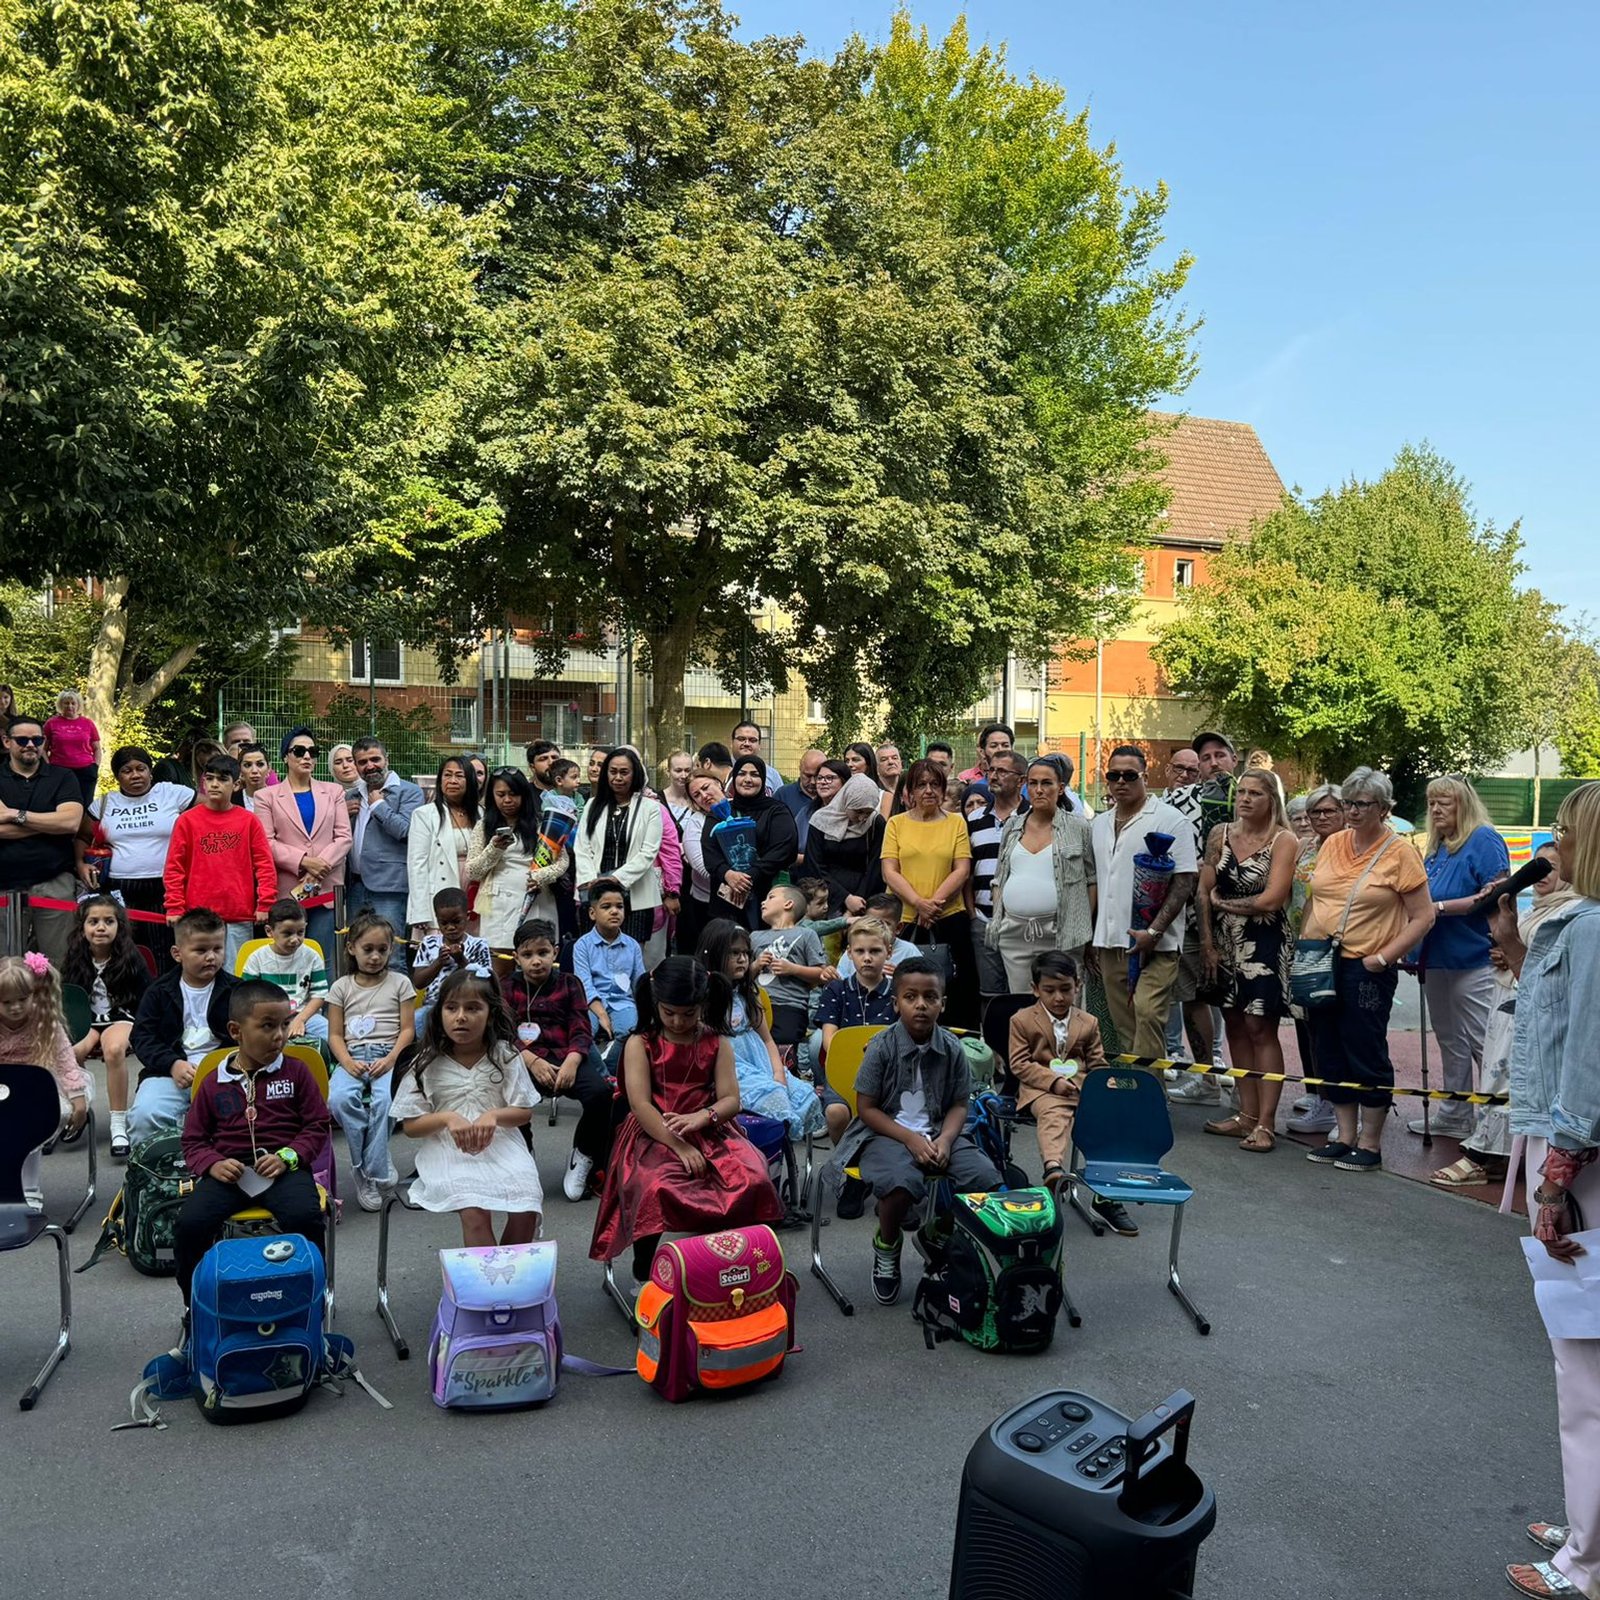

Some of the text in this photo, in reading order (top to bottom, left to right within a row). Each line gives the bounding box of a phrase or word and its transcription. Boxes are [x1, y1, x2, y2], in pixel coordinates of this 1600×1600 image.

[111, 802, 159, 817] PARIS
[115, 820, 155, 830] ATELIER
[266, 1082, 295, 1096] MC61
[721, 1271, 748, 1284] Scout
[464, 1367, 532, 1393] Sparkle
